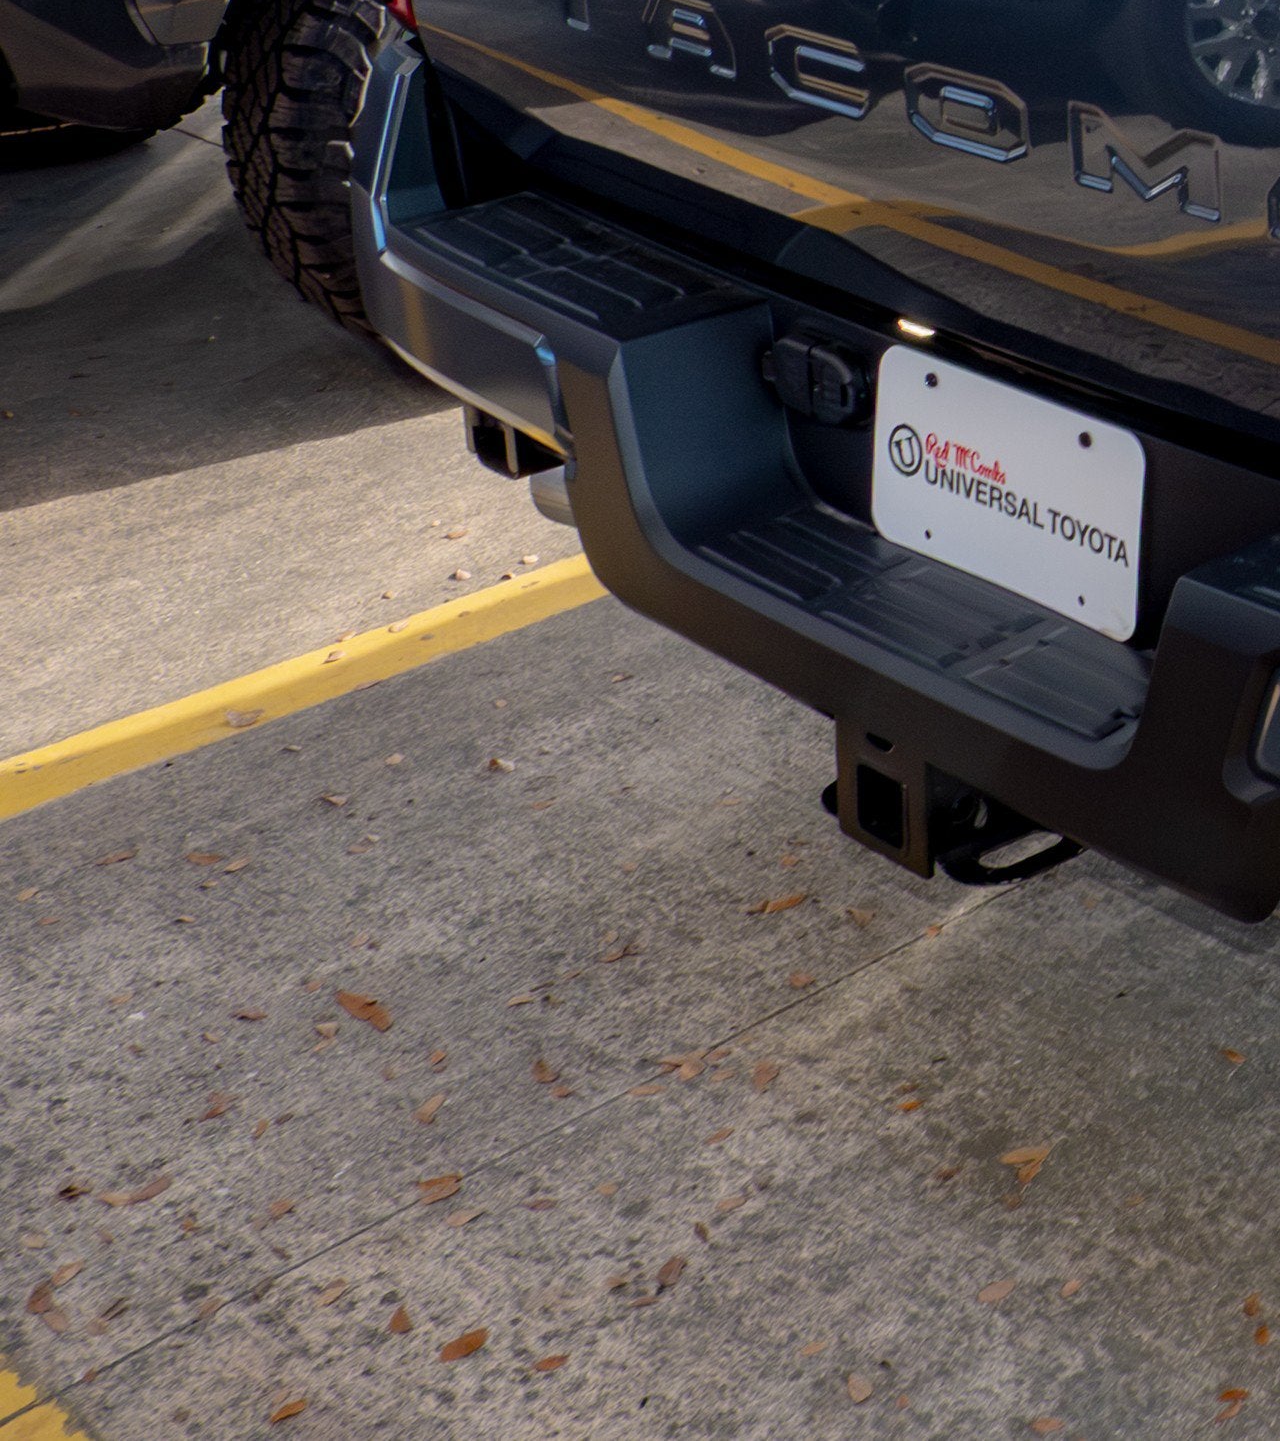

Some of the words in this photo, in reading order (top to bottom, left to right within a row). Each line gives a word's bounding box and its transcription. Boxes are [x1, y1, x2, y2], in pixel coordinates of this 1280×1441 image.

[925, 432, 949, 469] Red
[925, 459, 1044, 530] UNIVERSAL
[1048, 508, 1129, 568] TOYOTA
